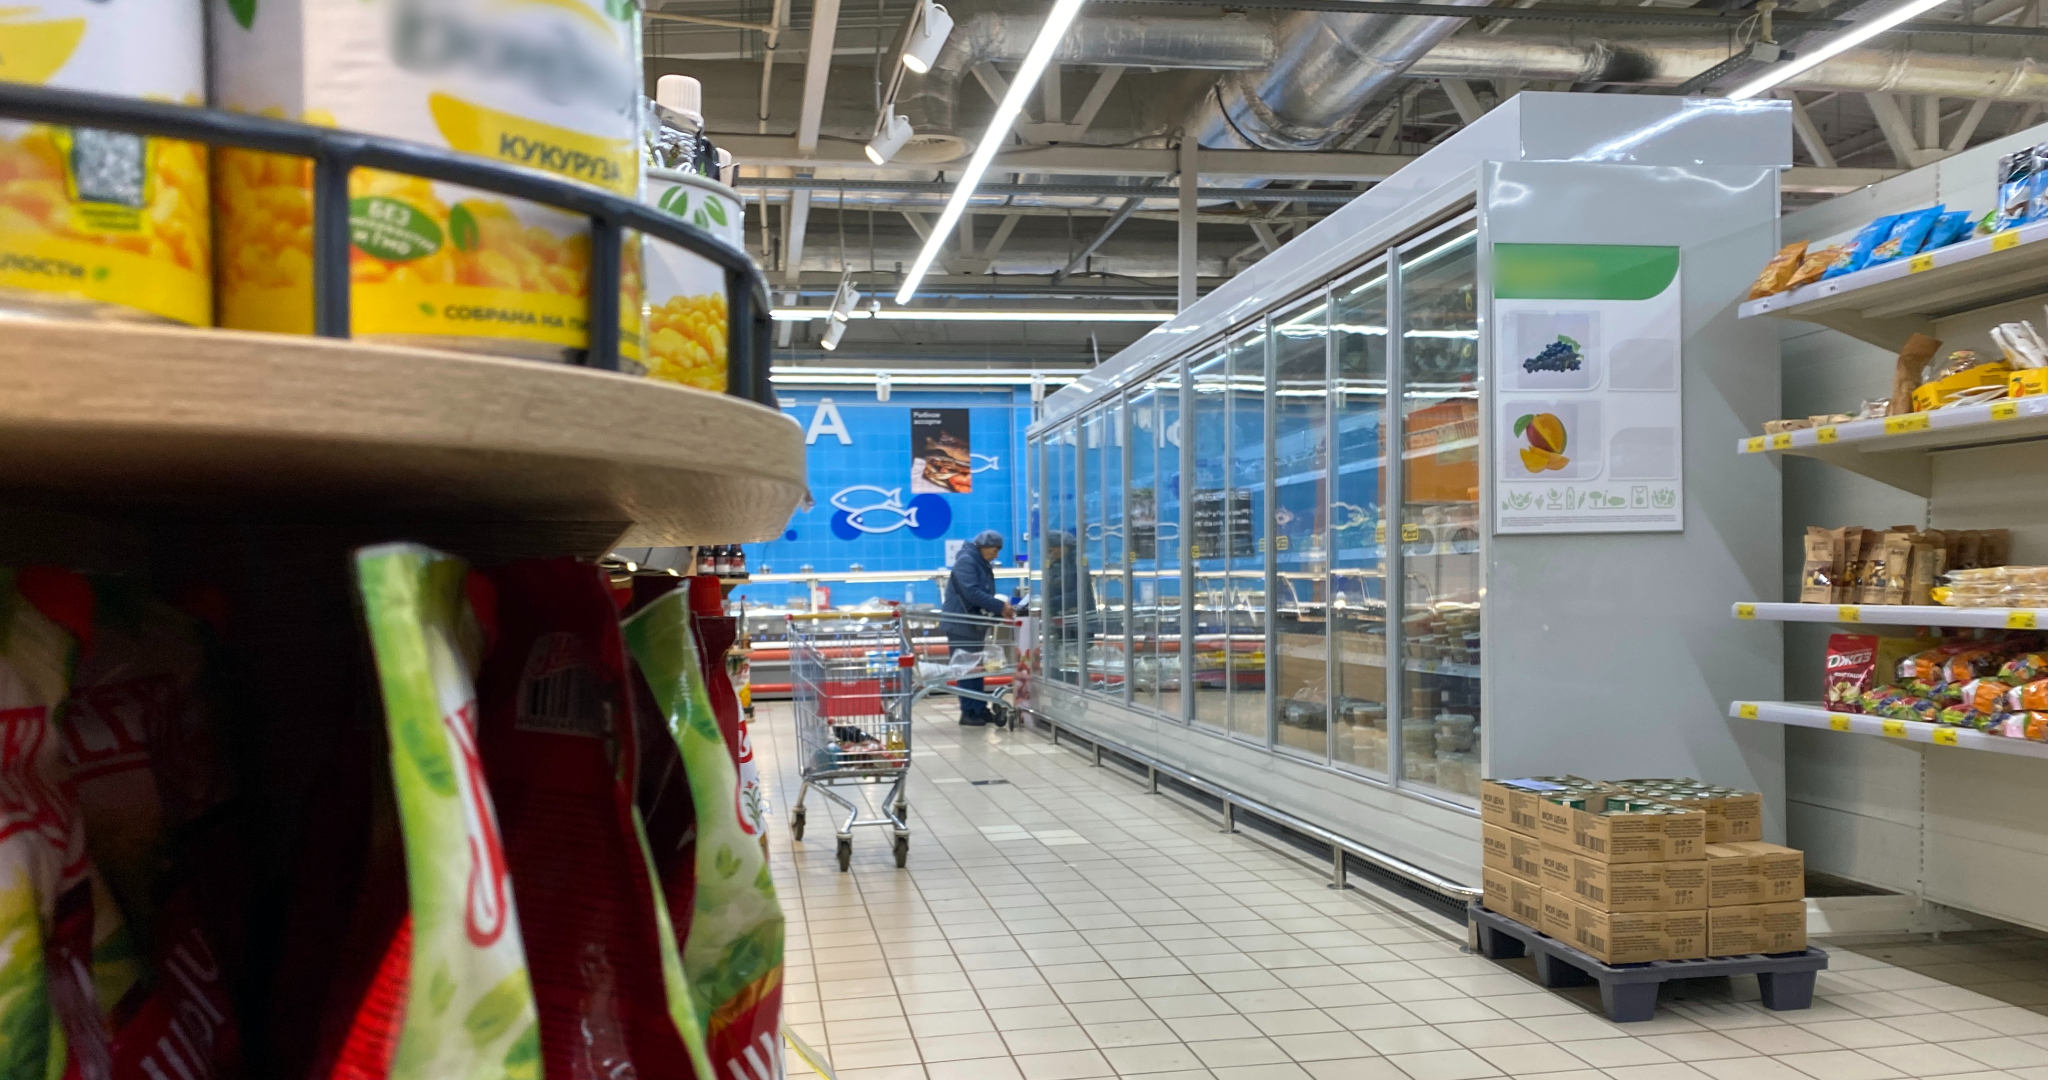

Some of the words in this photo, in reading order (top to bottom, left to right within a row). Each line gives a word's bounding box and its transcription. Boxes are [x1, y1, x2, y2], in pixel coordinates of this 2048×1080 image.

[499, 132, 622, 181] КУКУРУЗА
[367, 200, 412, 227] БЕЗ
[444, 303, 536, 325] СОБРАНА
[539, 313, 564, 329] НА
[1492, 796, 1504, 806] ЦЕНА
[1553, 815, 1567, 826] ЦЕНА
[1494, 839, 1506, 851] ЦЕНА
[1555, 861, 1568, 873] ЦЕНА
[1494, 882, 1507, 894] ЦЕНА
[1556, 908, 1569, 921] ЦЕНА
